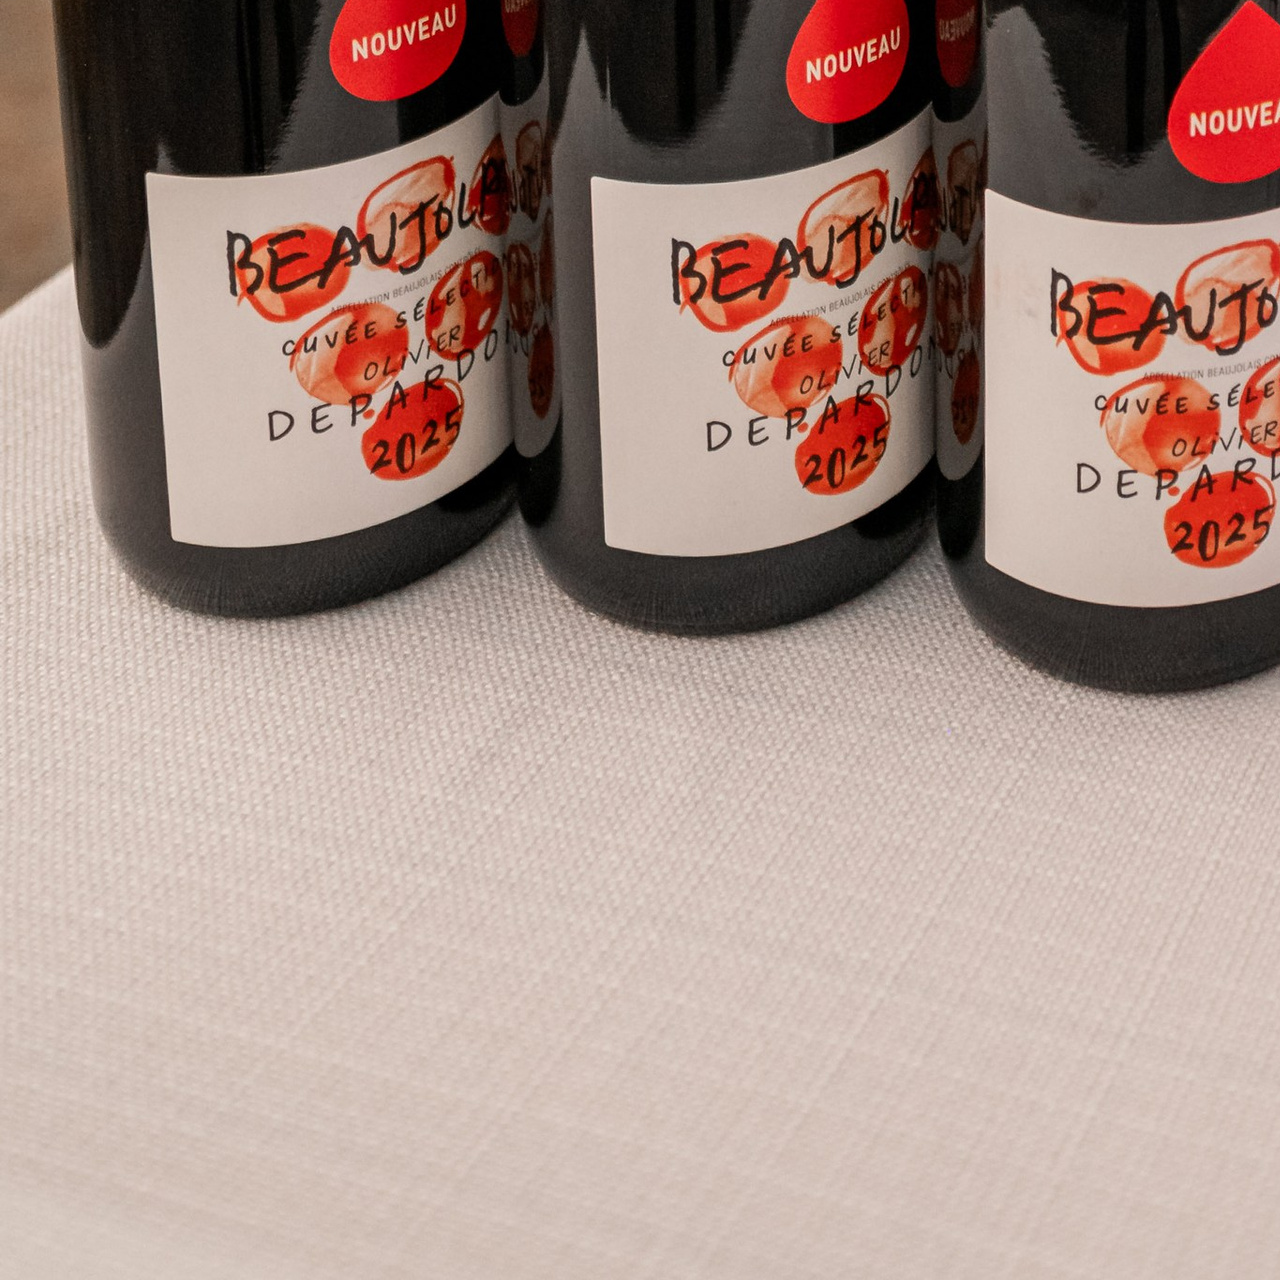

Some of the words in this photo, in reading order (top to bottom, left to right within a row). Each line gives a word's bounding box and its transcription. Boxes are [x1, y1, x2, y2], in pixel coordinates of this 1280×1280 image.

[351, 3, 457, 63] NOUVEAU
[806, 26, 901, 84] NOUVEAU
[282, 320, 377, 356] CUVÉE
[722, 333, 814, 368] CUVÉE
[1207, 359, 1261, 378] BEAUJOLAIS
[1094, 392, 1189, 416] CUVÉE
[370, 405, 462, 474] 2025
[802, 421, 889, 489] 2025
[1171, 505, 1275, 562] 2025
